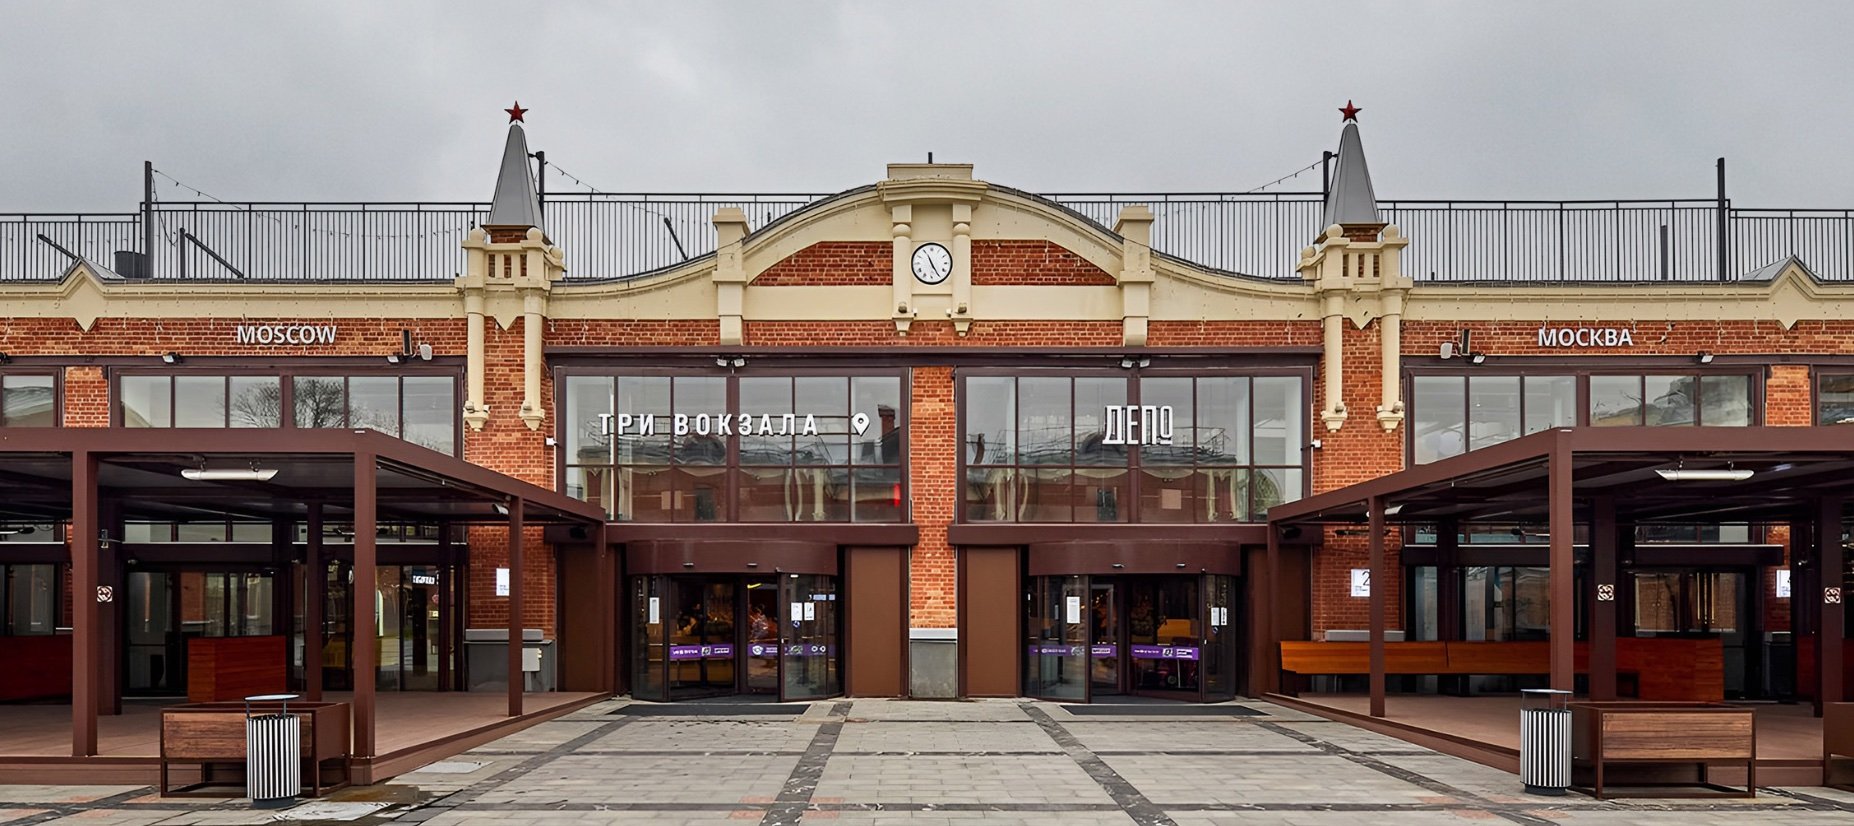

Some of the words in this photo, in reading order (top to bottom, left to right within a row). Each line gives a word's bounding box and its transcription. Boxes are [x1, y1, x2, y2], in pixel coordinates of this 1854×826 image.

[237, 325, 337, 344] MOSCOW
[1538, 328, 1634, 347] МОСКВА
[598, 413, 655, 436] ТРИ
[674, 413, 818, 436] ВОКЗАЛА
[1102, 405, 1173, 445] ДЕПО
